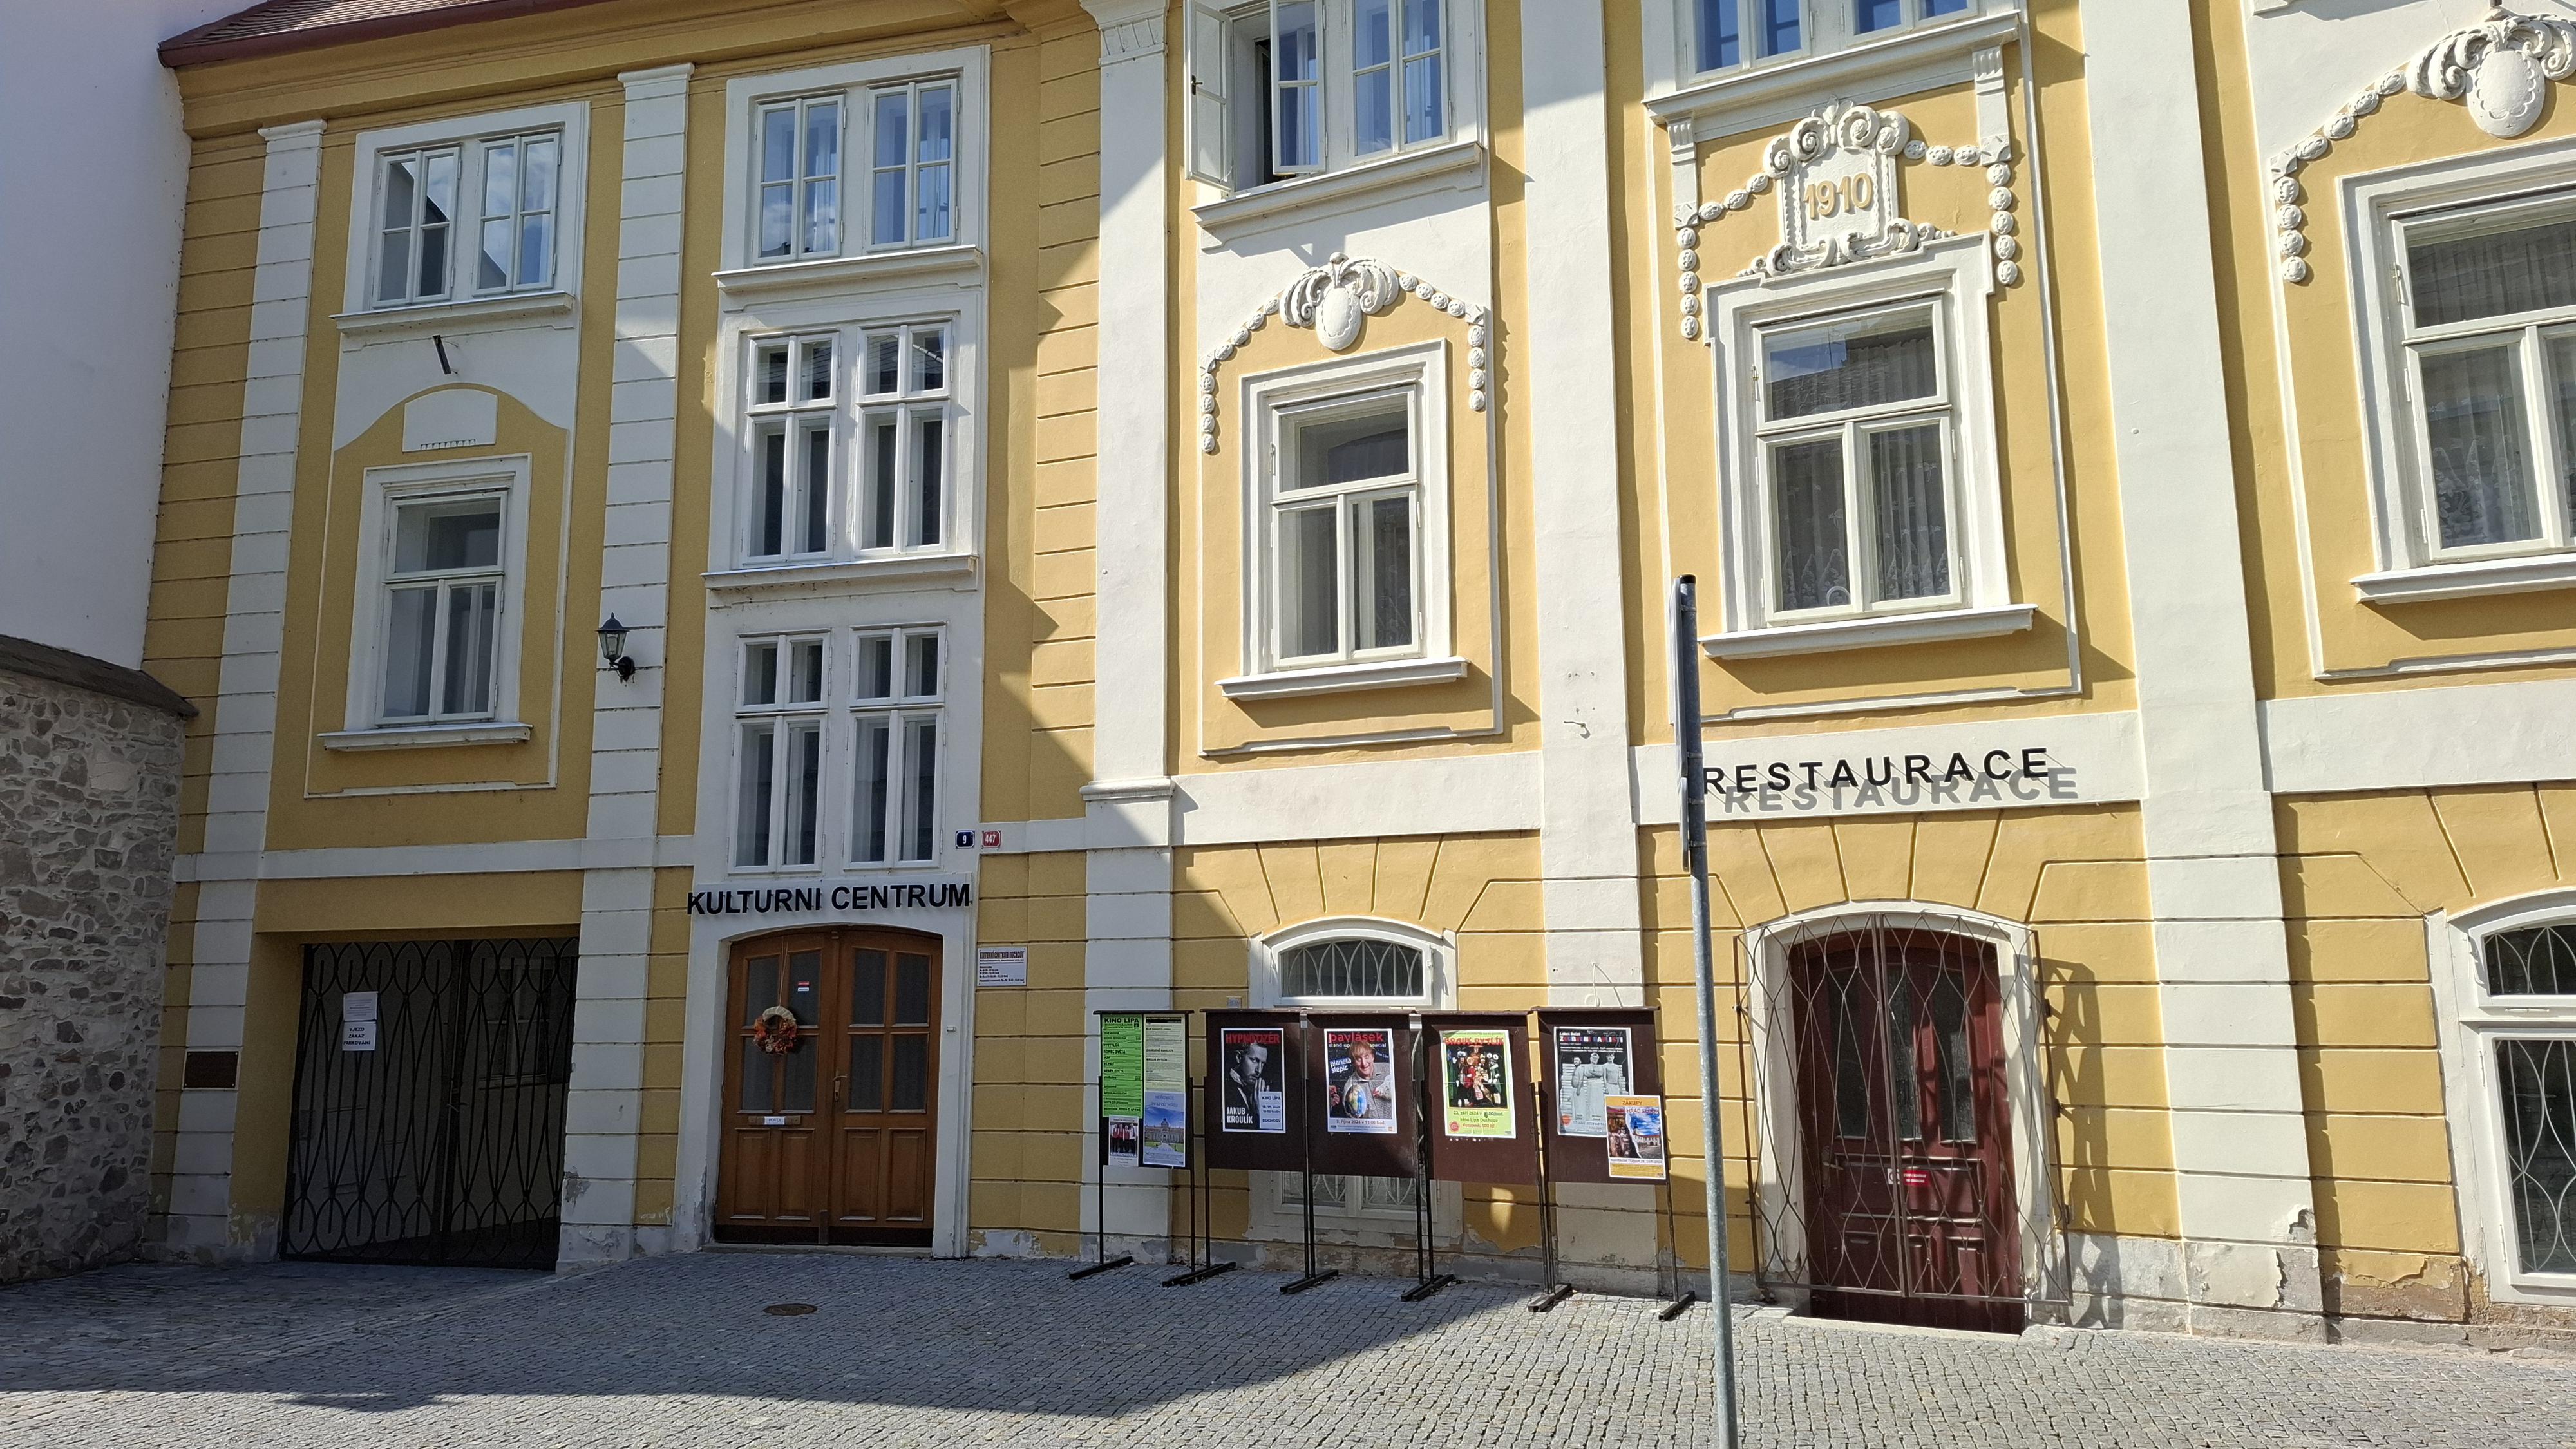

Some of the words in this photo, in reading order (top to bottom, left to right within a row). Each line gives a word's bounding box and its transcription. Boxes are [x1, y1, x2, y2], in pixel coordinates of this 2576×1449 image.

[1803, 173, 1871, 220] 1910
[1703, 748, 2049, 795] RESTAURACE
[963, 835, 967, 844] 9
[985, 834, 996, 843] 447
[687, 887, 820, 915] KULTURNI
[831, 884, 970, 910] CENTRUM
[1226, 1106, 1245, 1115] JAKUB
[1227, 1113, 1253, 1124] KROULÍK
